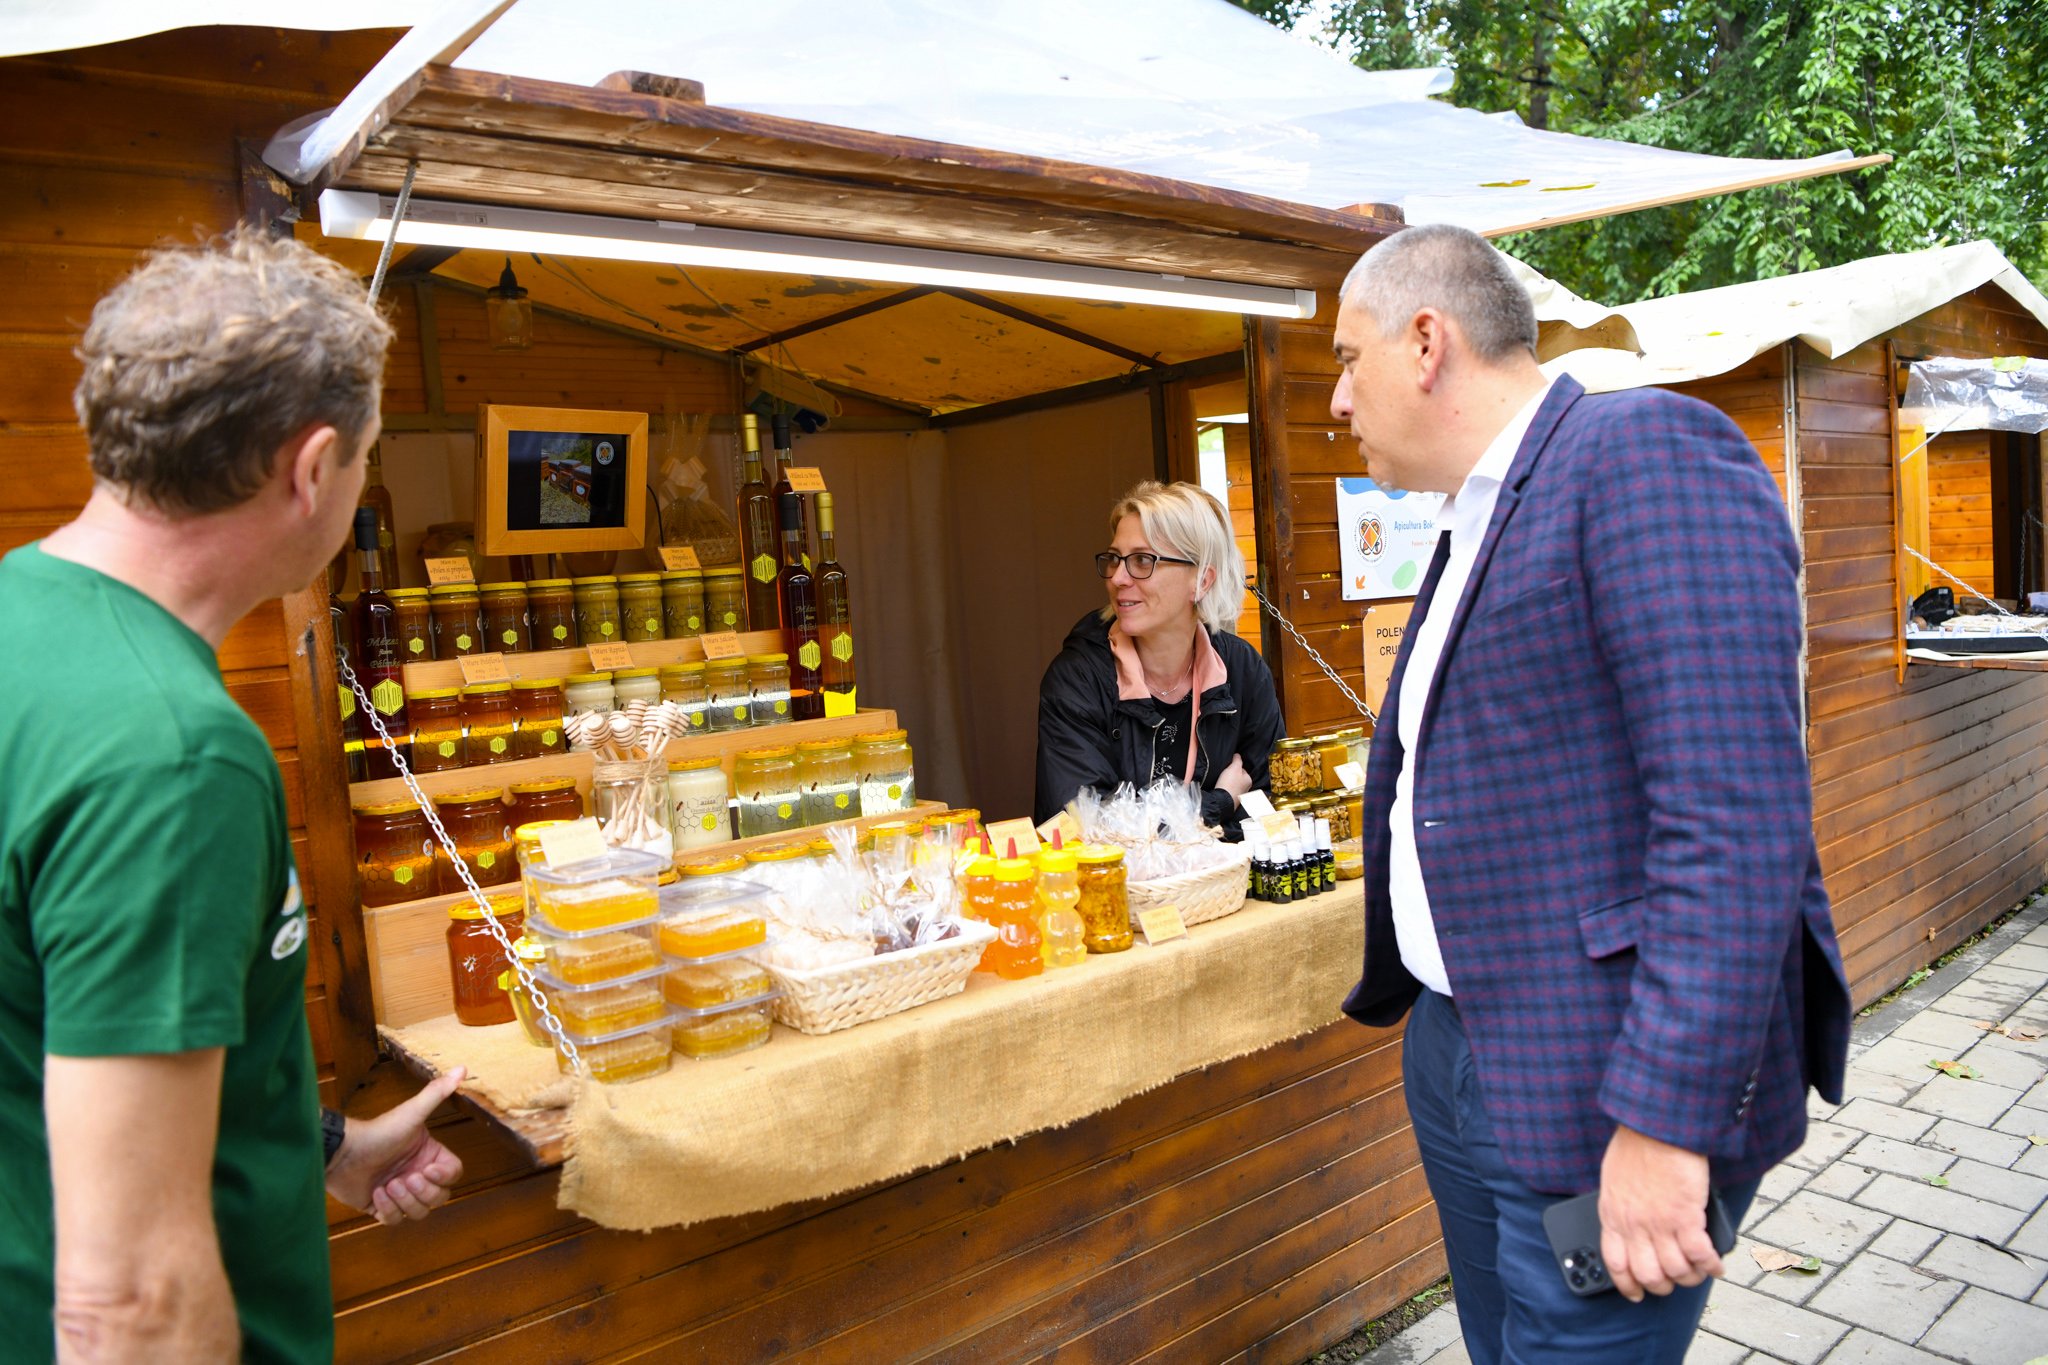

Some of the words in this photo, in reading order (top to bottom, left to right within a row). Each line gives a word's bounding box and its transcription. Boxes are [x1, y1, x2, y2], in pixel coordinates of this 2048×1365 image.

[1393, 519, 1421, 533] Apicultura
[1423, 519, 1435, 530] Bok
[1380, 644, 1400, 656] CRU
